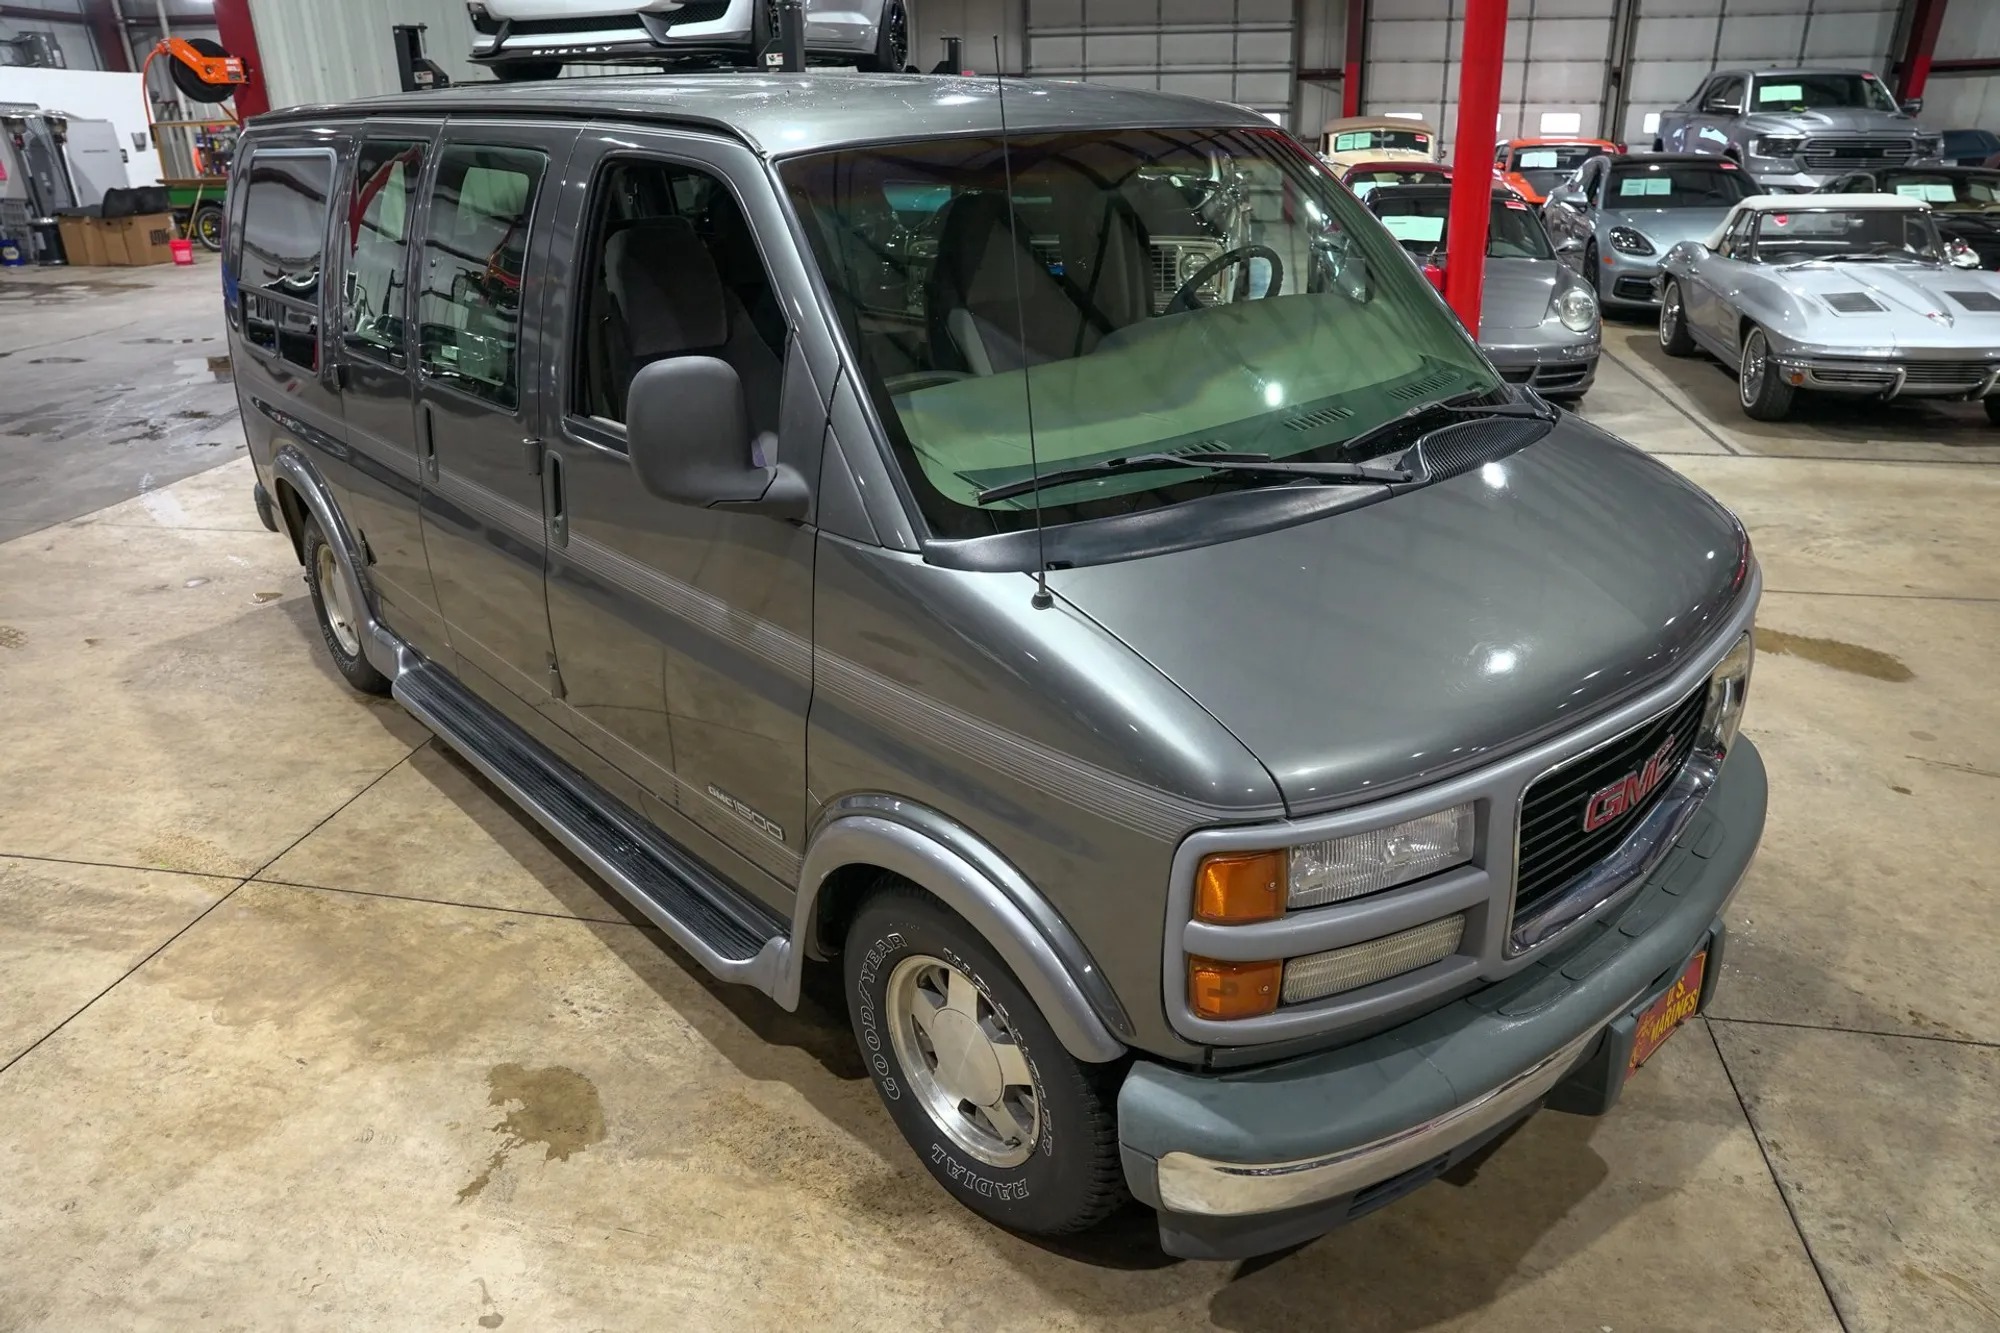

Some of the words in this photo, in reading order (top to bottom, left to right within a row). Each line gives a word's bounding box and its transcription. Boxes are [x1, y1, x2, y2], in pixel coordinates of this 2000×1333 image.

[1583, 733, 1675, 833] GMC
[708, 785, 734, 808] GMC
[732, 799, 783, 841] 1500
[1651, 988, 1698, 1043] MARINES
[931, 1142, 1030, 1201] RADIAL
